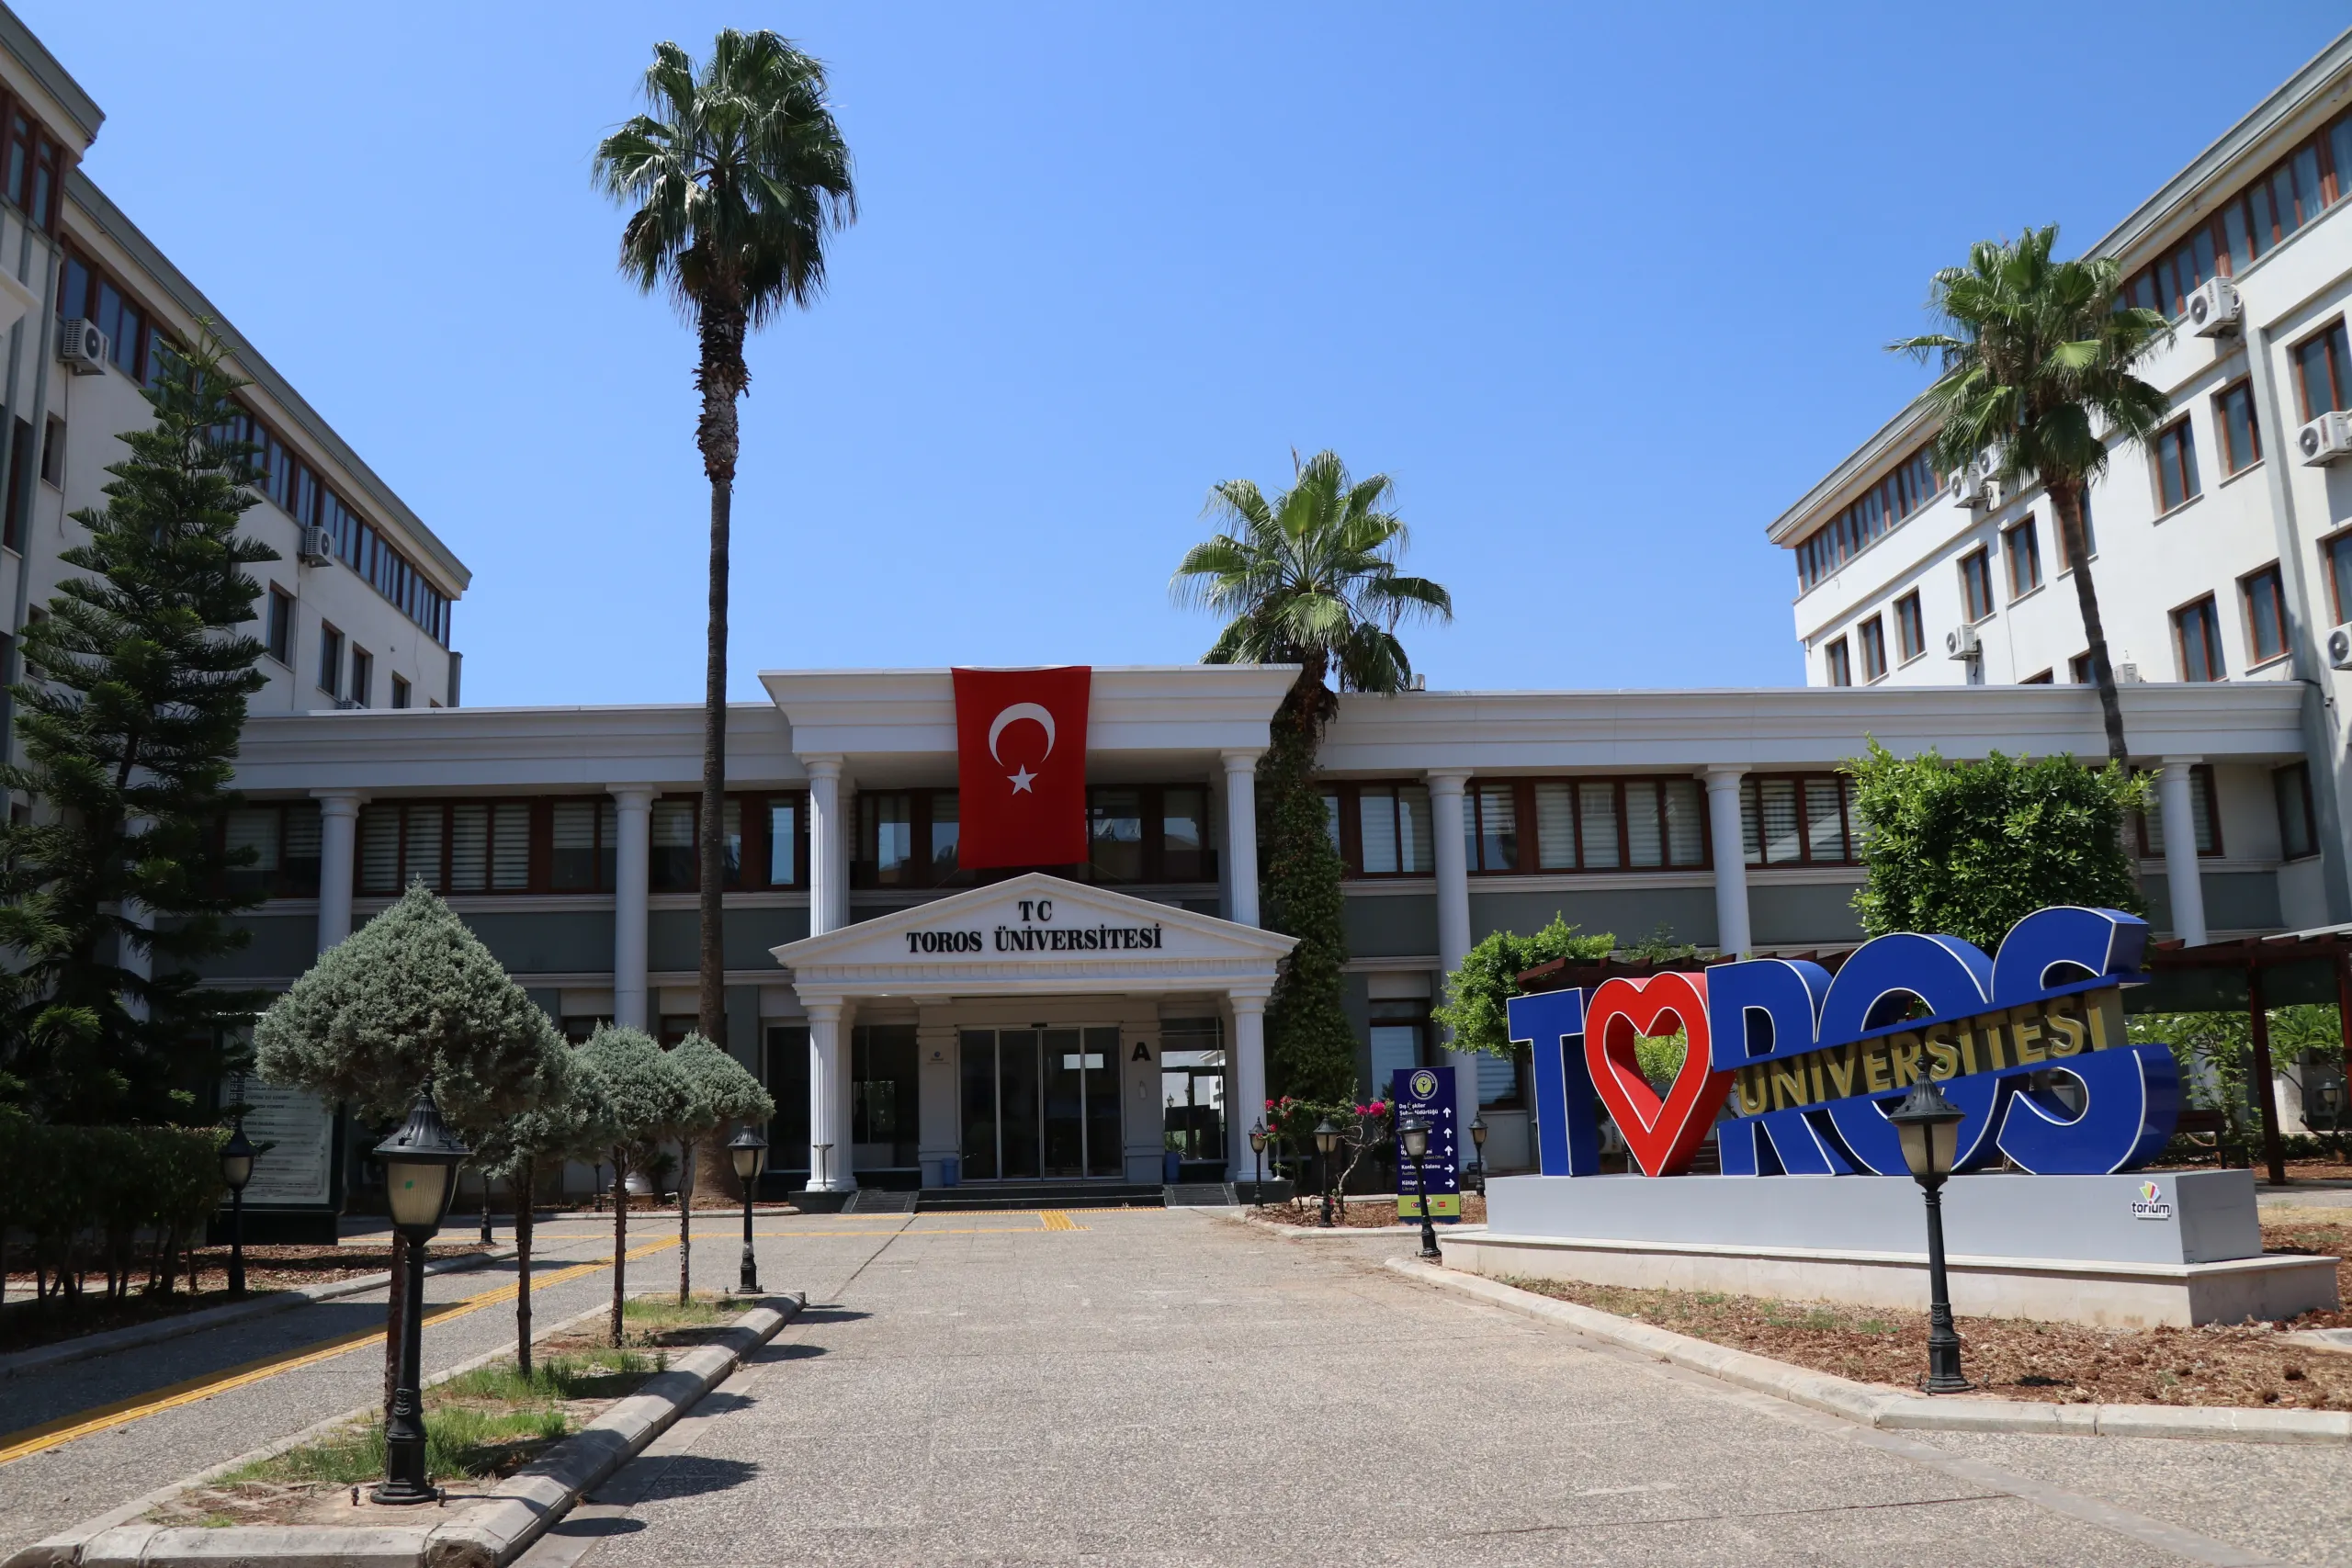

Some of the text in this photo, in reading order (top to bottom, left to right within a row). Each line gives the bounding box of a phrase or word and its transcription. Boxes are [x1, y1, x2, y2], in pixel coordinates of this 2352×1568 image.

[907, 923, 1162, 953] TOROS ÜNİVERSİTESİ
[1132, 1042, 1151, 1062] A
[2132, 1200, 2170, 1214] torium
